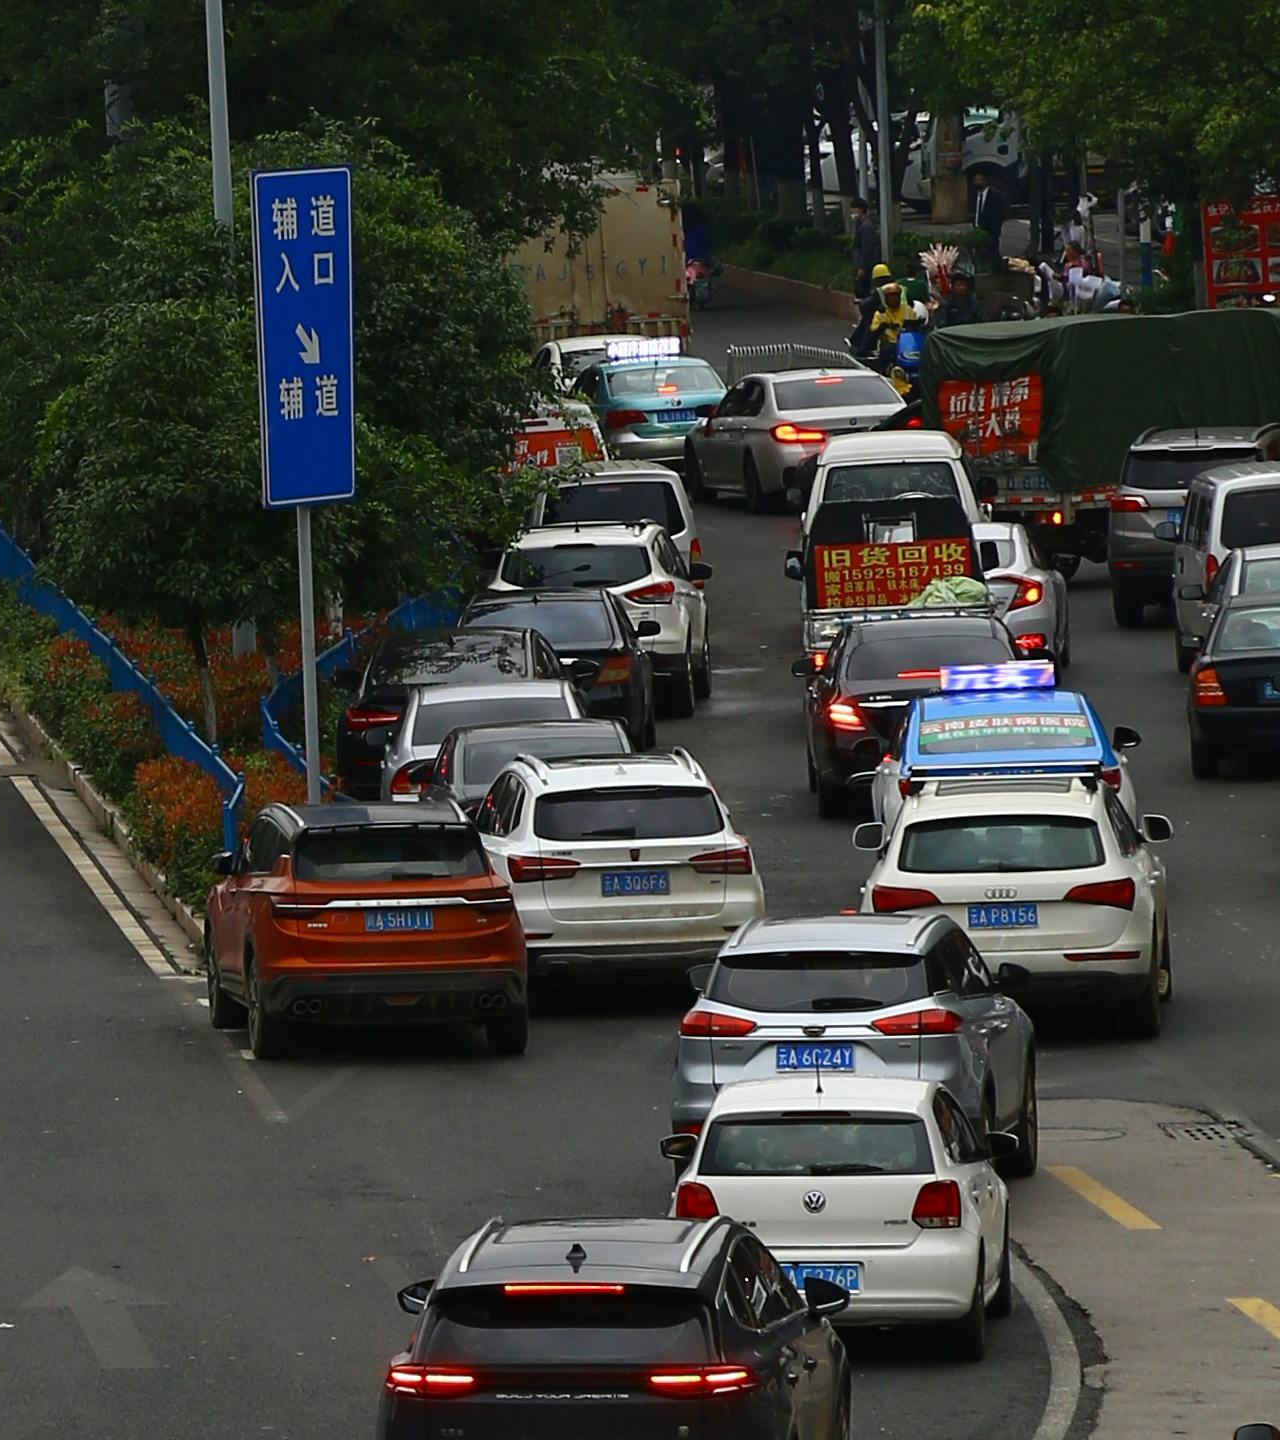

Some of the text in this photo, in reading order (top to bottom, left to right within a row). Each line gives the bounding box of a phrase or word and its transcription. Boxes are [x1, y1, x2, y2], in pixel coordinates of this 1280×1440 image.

[271, 194, 336, 241] 辅道
[275, 251, 335, 294] 入口
[279, 374, 339, 421] 辅道
[823, 542, 966, 568] 旧货回收
[842, 563, 965, 580] 15925187139
[921, 716, 1087, 735] 云南皮肤病医院
